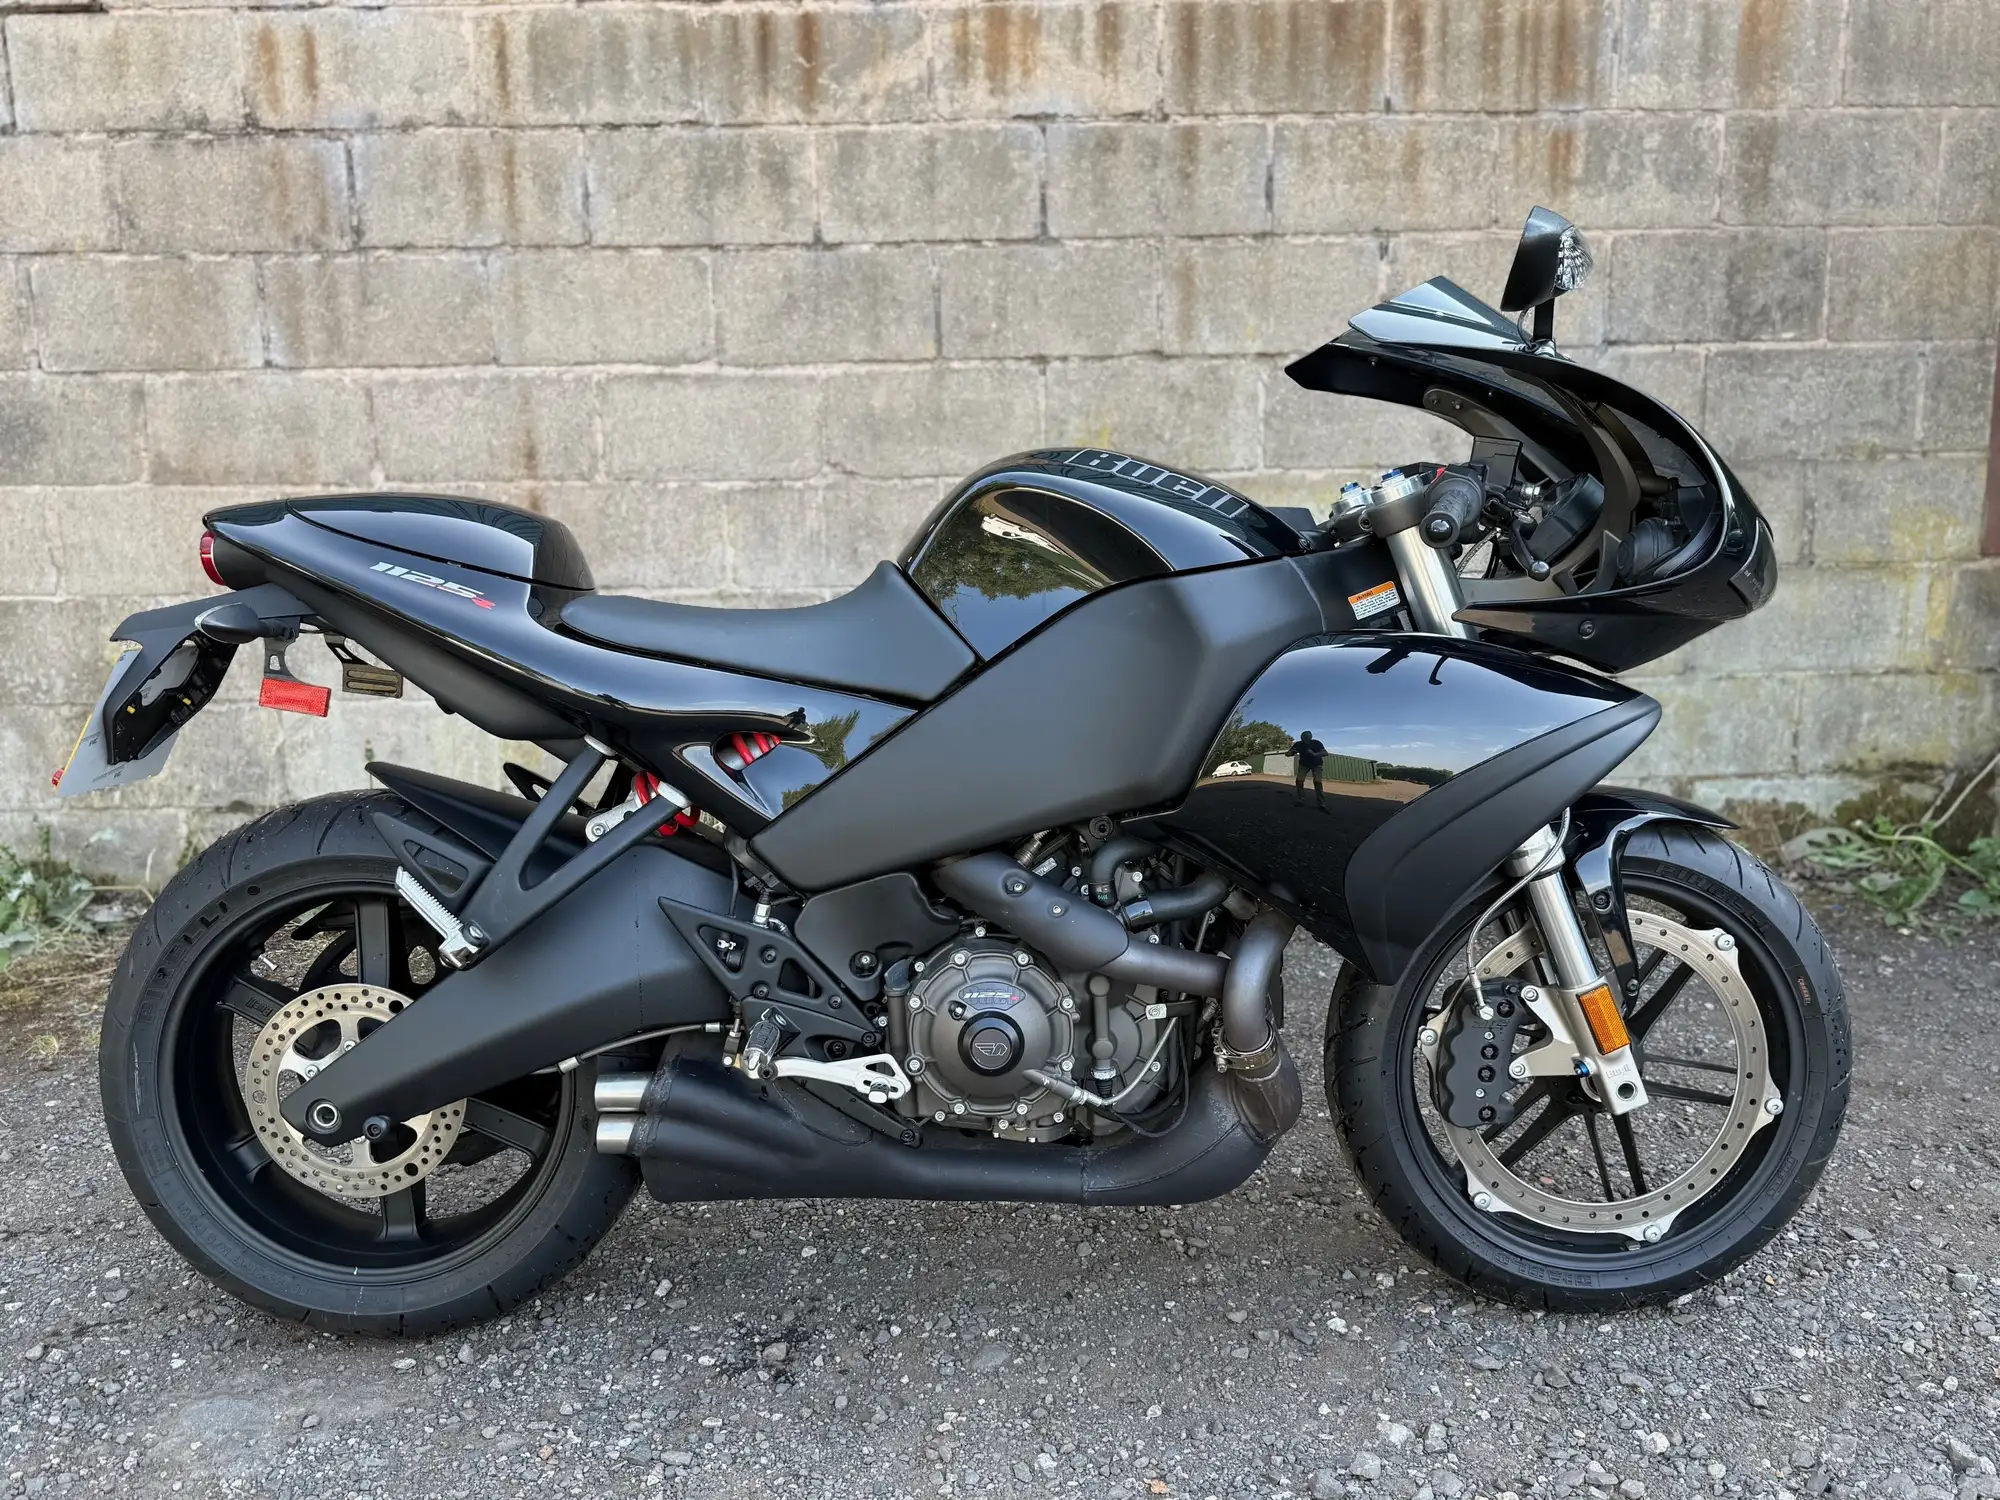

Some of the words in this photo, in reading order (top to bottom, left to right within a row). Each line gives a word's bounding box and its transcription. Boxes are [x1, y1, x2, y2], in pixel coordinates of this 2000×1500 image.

[1063, 448, 1249, 519] Buell
[1656, 863, 1773, 933] PIRELLI
[138, 900, 231, 1023] PIRELLI
